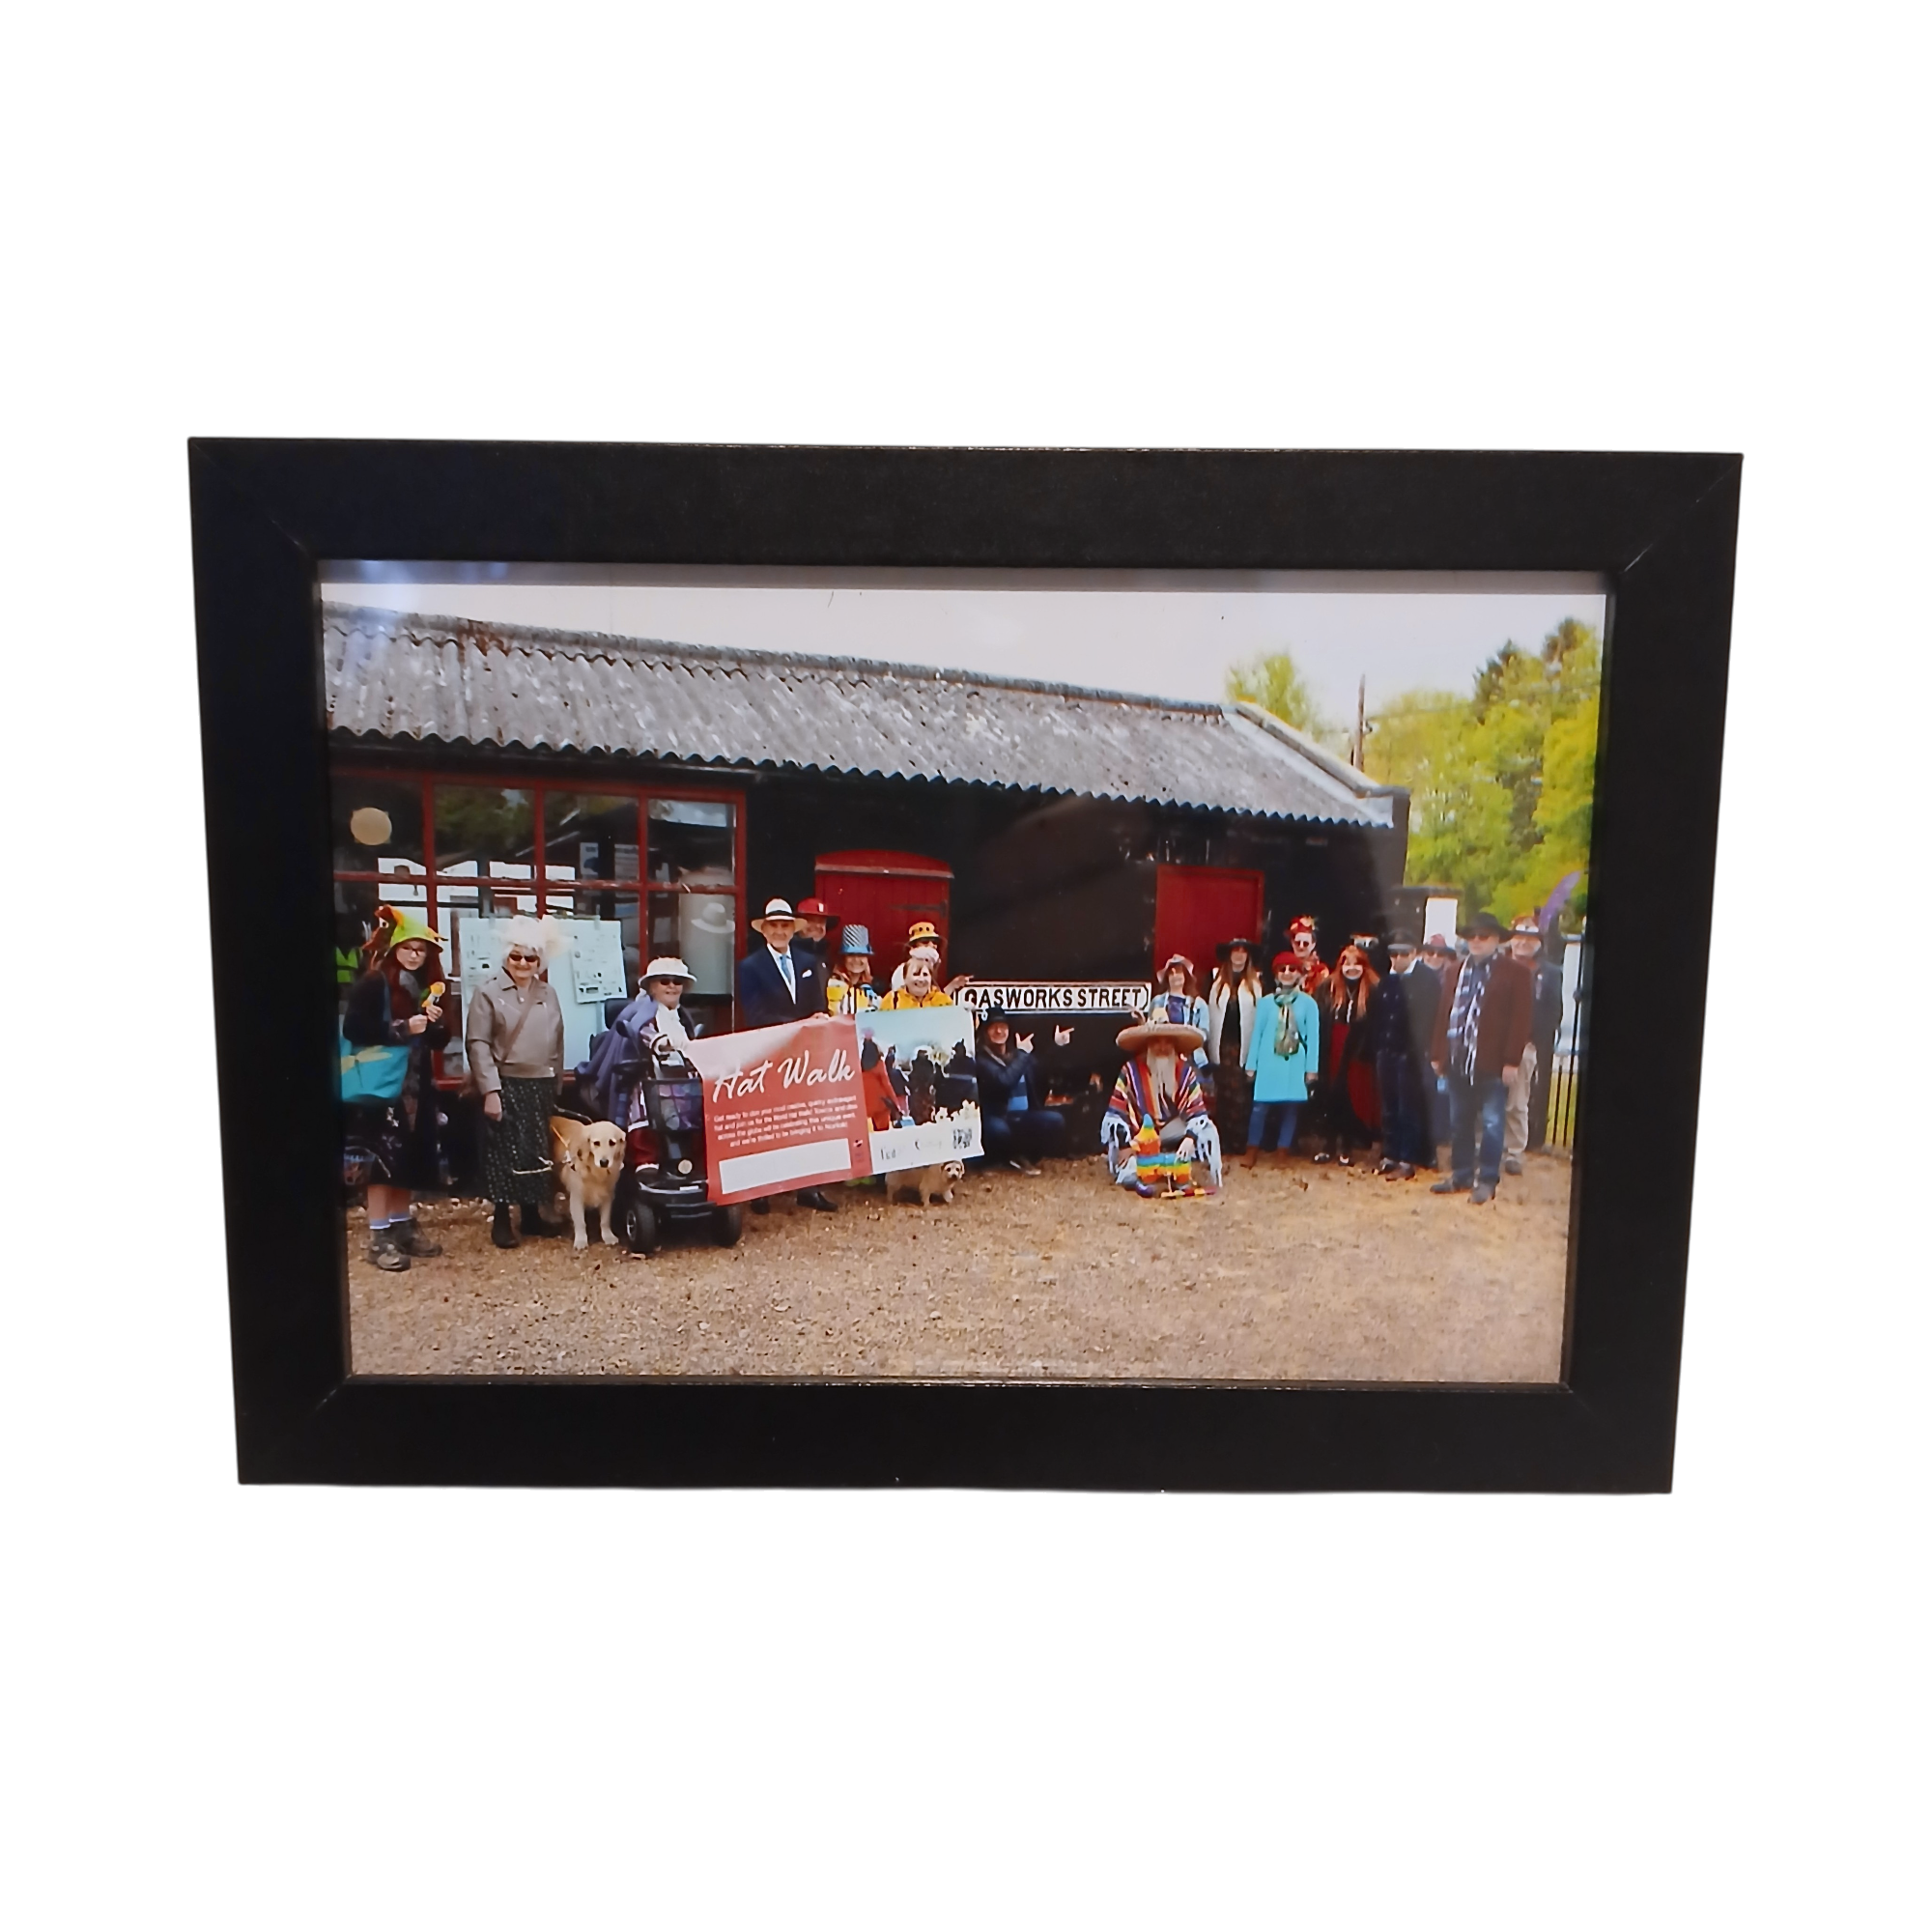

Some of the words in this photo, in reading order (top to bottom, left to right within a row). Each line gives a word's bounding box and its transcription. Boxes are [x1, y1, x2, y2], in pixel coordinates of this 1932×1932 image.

[1077, 987, 1142, 1008] STREET
[712, 1059, 773, 1102] Hat
[777, 1048, 855, 1089] Walk
